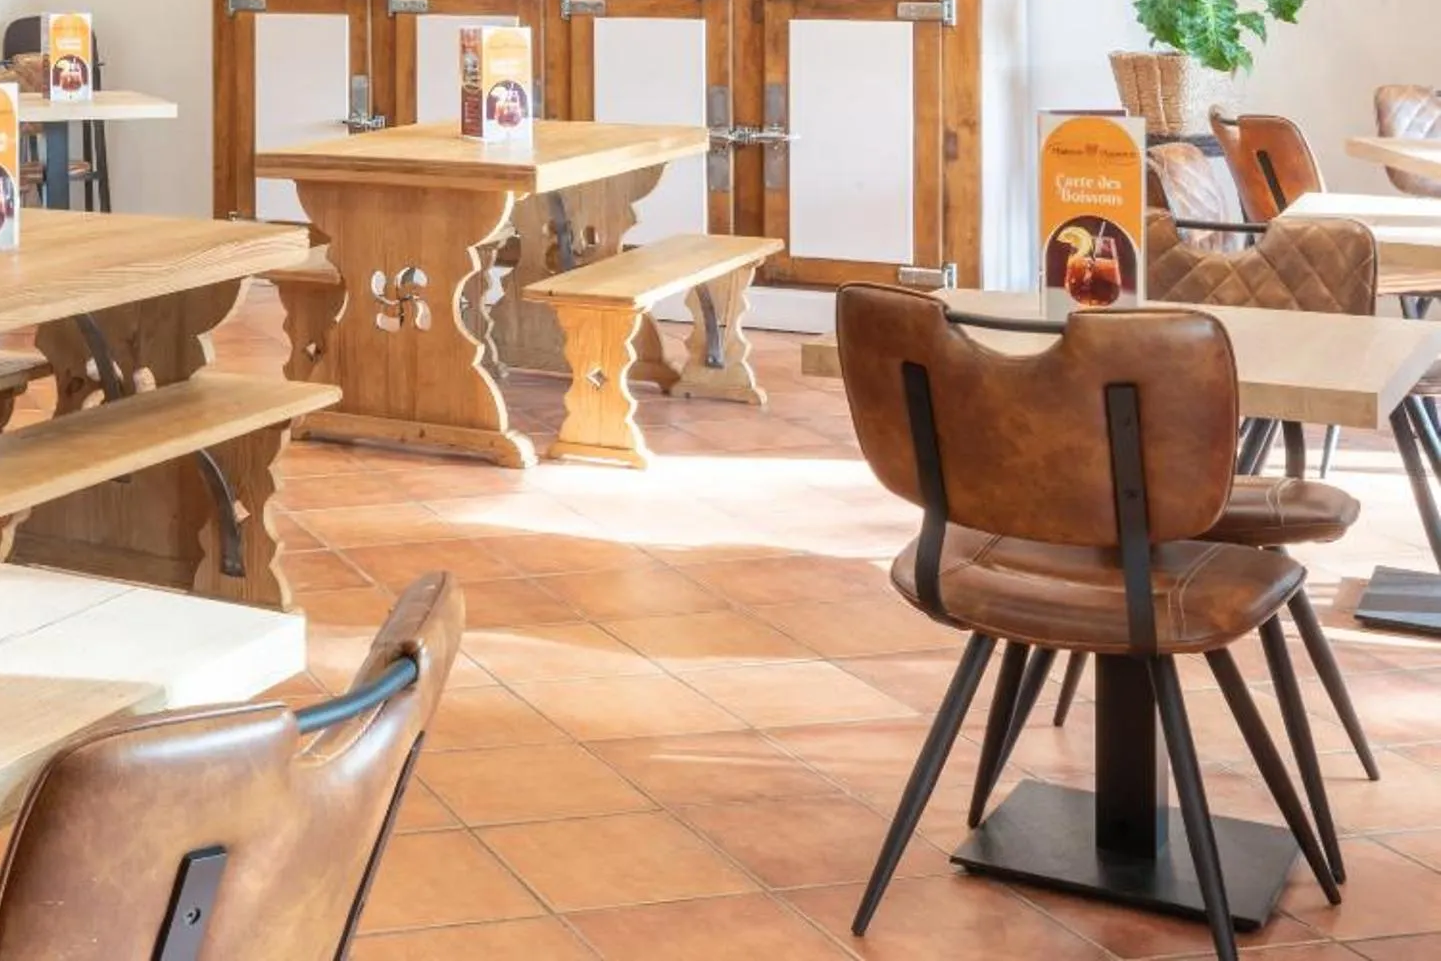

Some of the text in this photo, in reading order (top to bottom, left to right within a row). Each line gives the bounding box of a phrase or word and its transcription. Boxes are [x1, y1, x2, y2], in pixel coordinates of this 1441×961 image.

[1056, 174, 1123, 190] Carte des
[1061, 188, 1125, 206] Boissons
